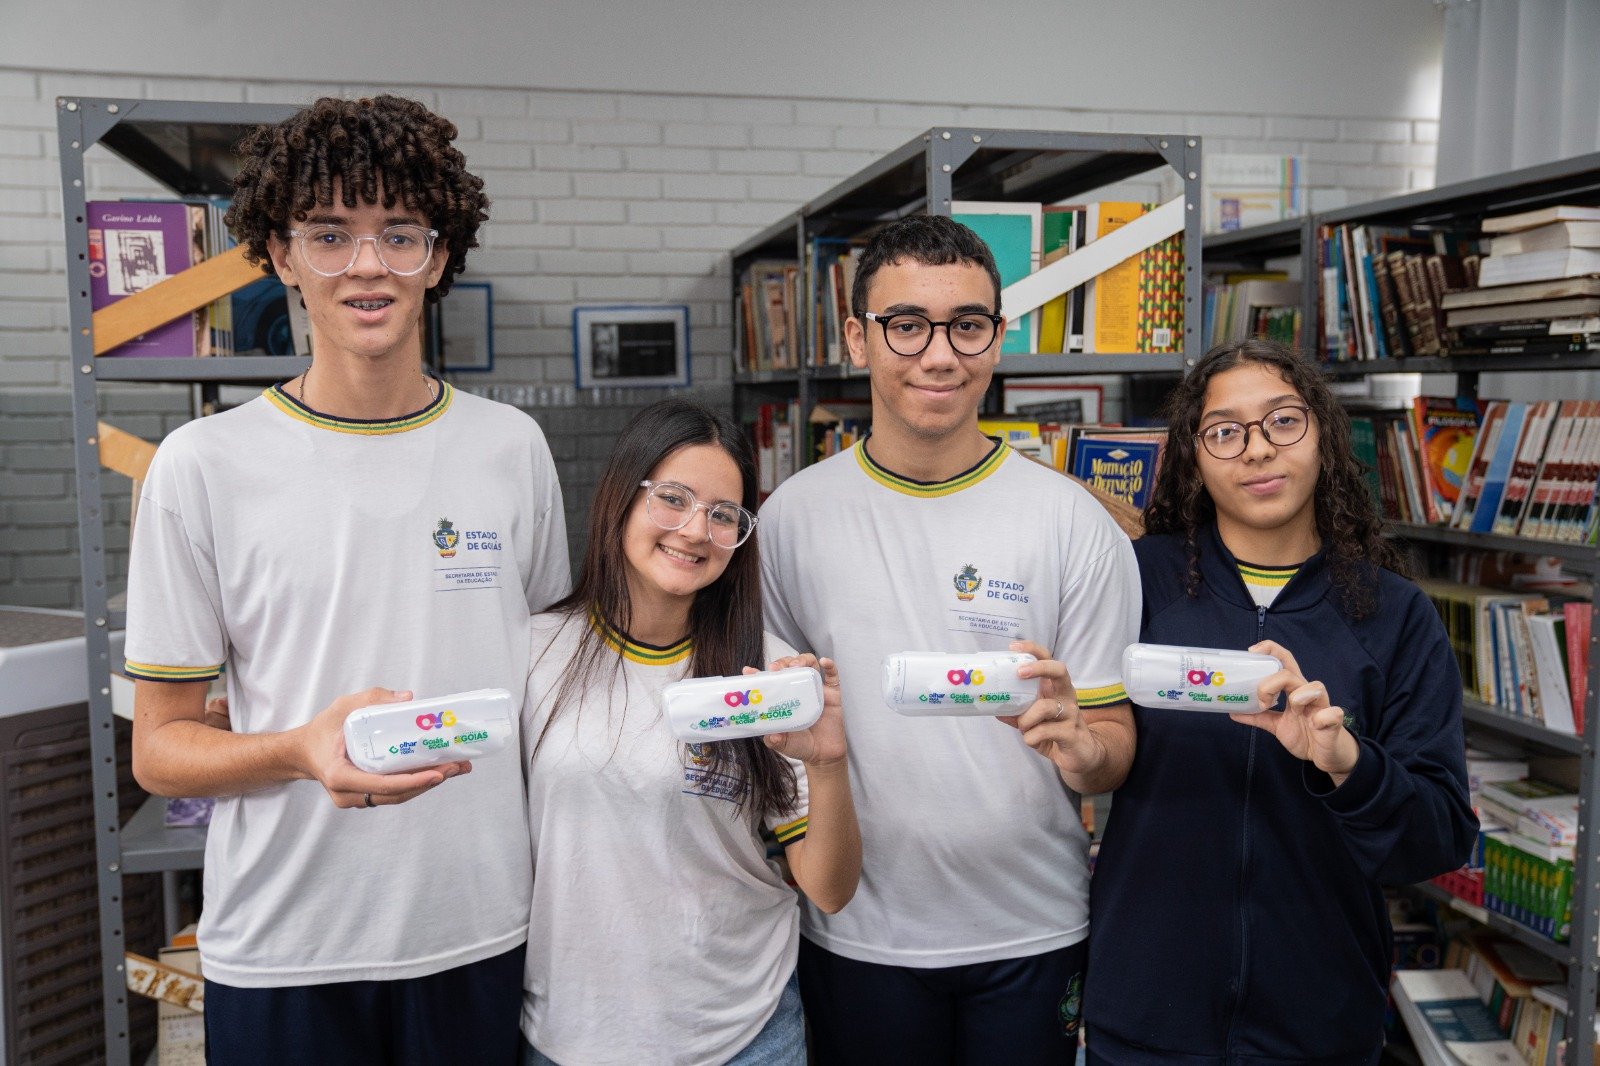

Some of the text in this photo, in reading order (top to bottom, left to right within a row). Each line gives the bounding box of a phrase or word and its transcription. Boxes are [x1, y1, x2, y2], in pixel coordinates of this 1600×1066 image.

[102, 213, 162, 223] Gavino Ledda
[466, 531, 498, 540] ESTADO
[467, 541, 502, 551] DE GOIÁS
[988, 580, 1025, 592] ESTADO
[987, 590, 1029, 604] DE GOIÁS
[958, 615, 990, 624] SECRETARIA
[422, 737, 444, 746] Goiás
